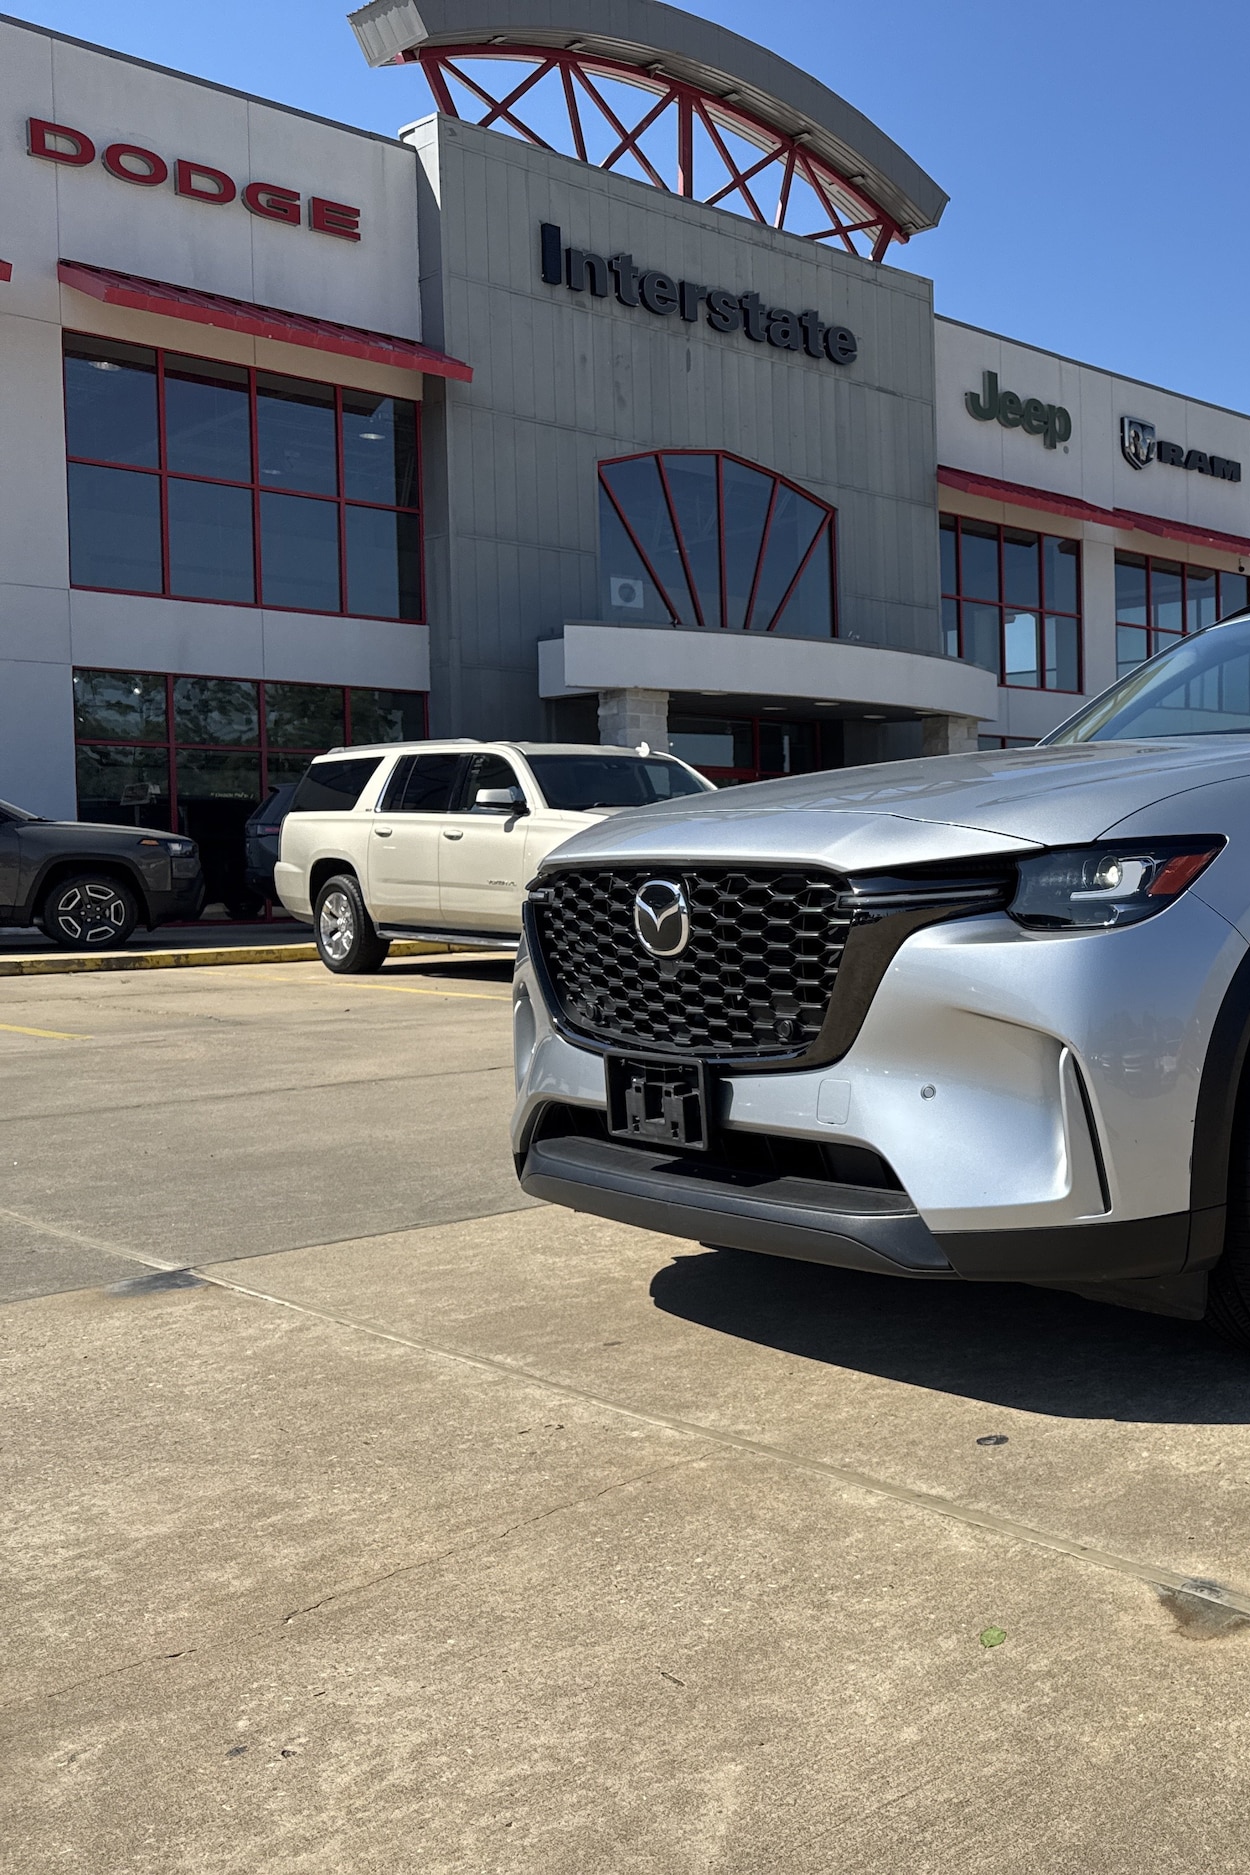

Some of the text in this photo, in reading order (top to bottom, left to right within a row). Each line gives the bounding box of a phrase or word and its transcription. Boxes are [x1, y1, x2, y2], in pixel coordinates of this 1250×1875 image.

[26, 117, 361, 242] DODGE
[540, 222, 858, 365] Interstate
[964, 370, 1072, 450] Jeep
[1157, 440, 1242, 483] RAM
